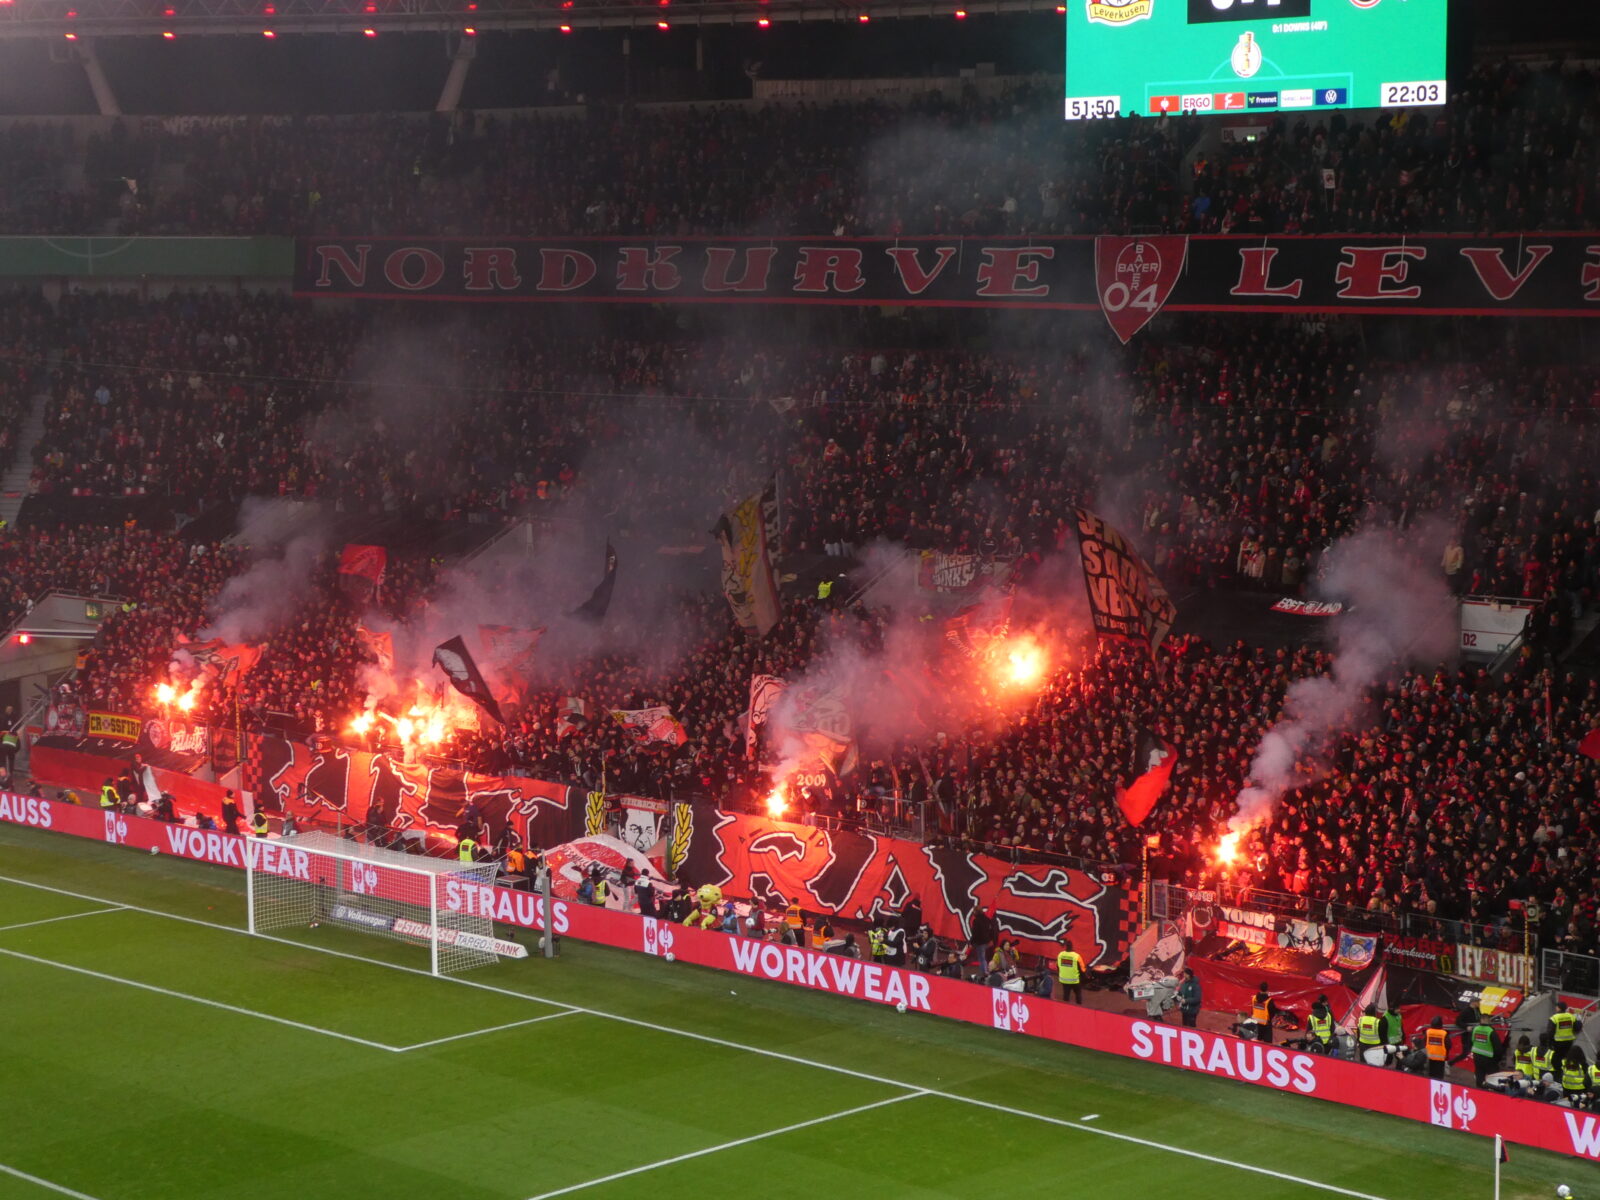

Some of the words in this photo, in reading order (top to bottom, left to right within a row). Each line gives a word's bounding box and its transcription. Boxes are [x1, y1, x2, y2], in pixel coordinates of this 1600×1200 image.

[1094, 5, 1145, 19] Leverkusen
[1184, 97, 1210, 108] ERGO
[1388, 84, 1438, 103] 22:03
[1072, 100, 1115, 117] 51:50
[316, 244, 1055, 297] NORDKURVE
[1230, 245, 1600, 302] LEV
[1117, 263, 1159, 272] BAYER
[1104, 282, 1158, 312] 04
[1463, 633, 1477, 646] D2
[166, 825, 311, 881] WORKWEAR
[347, 905, 387, 926] Volkswagen
[1220, 906, 1275, 931] YOUNG
[1227, 925, 1267, 945] BOYS
[494, 942, 520, 956] BANK
[1384, 942, 1437, 960] Leverkusen
[729, 937, 931, 1010] WORKWEAR
[1457, 944, 1483, 978] LEV
[1498, 951, 1535, 988] ELITE
[1131, 1021, 1316, 1093] STRAUSS
